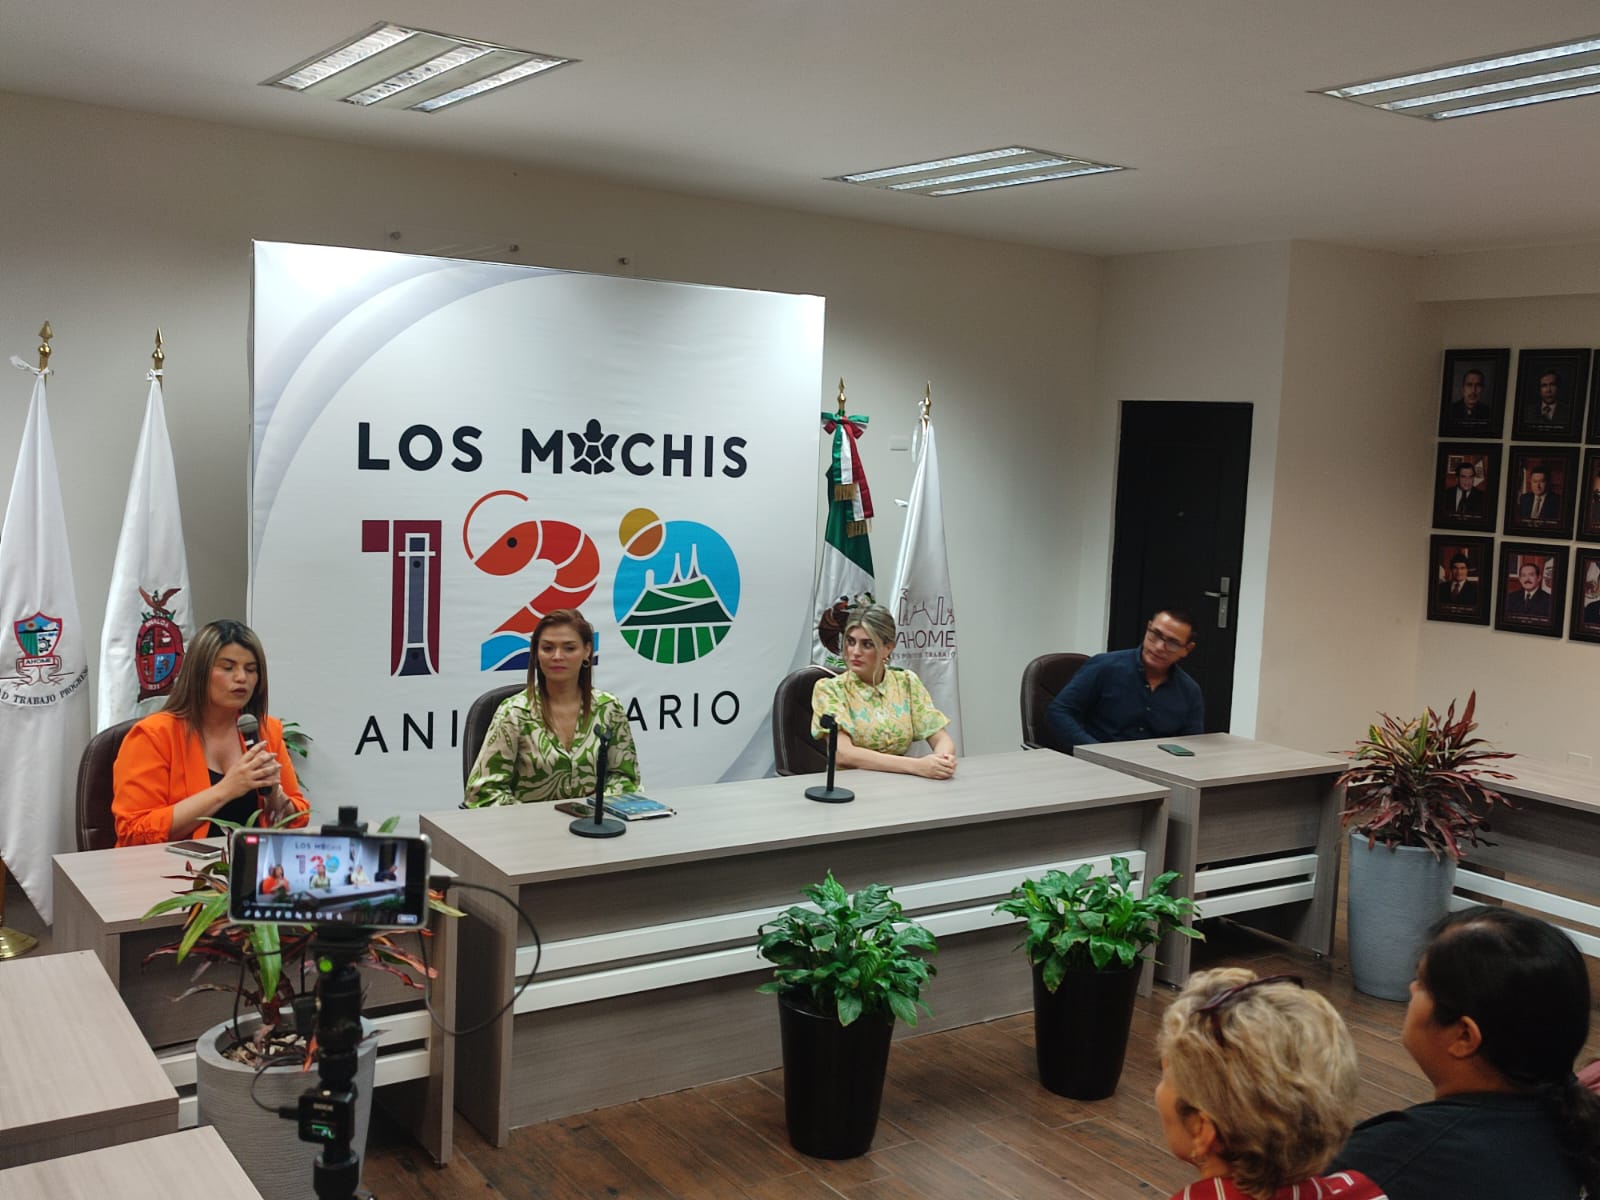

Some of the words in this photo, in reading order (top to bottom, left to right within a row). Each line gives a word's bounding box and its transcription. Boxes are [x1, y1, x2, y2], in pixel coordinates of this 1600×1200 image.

[358, 422, 483, 472] LOS
[361, 490, 741, 677] 120
[896, 630, 956, 648] AHOME
[13, 693, 56, 705] TRABAJO
[354, 690, 740, 755] ANIARIO
